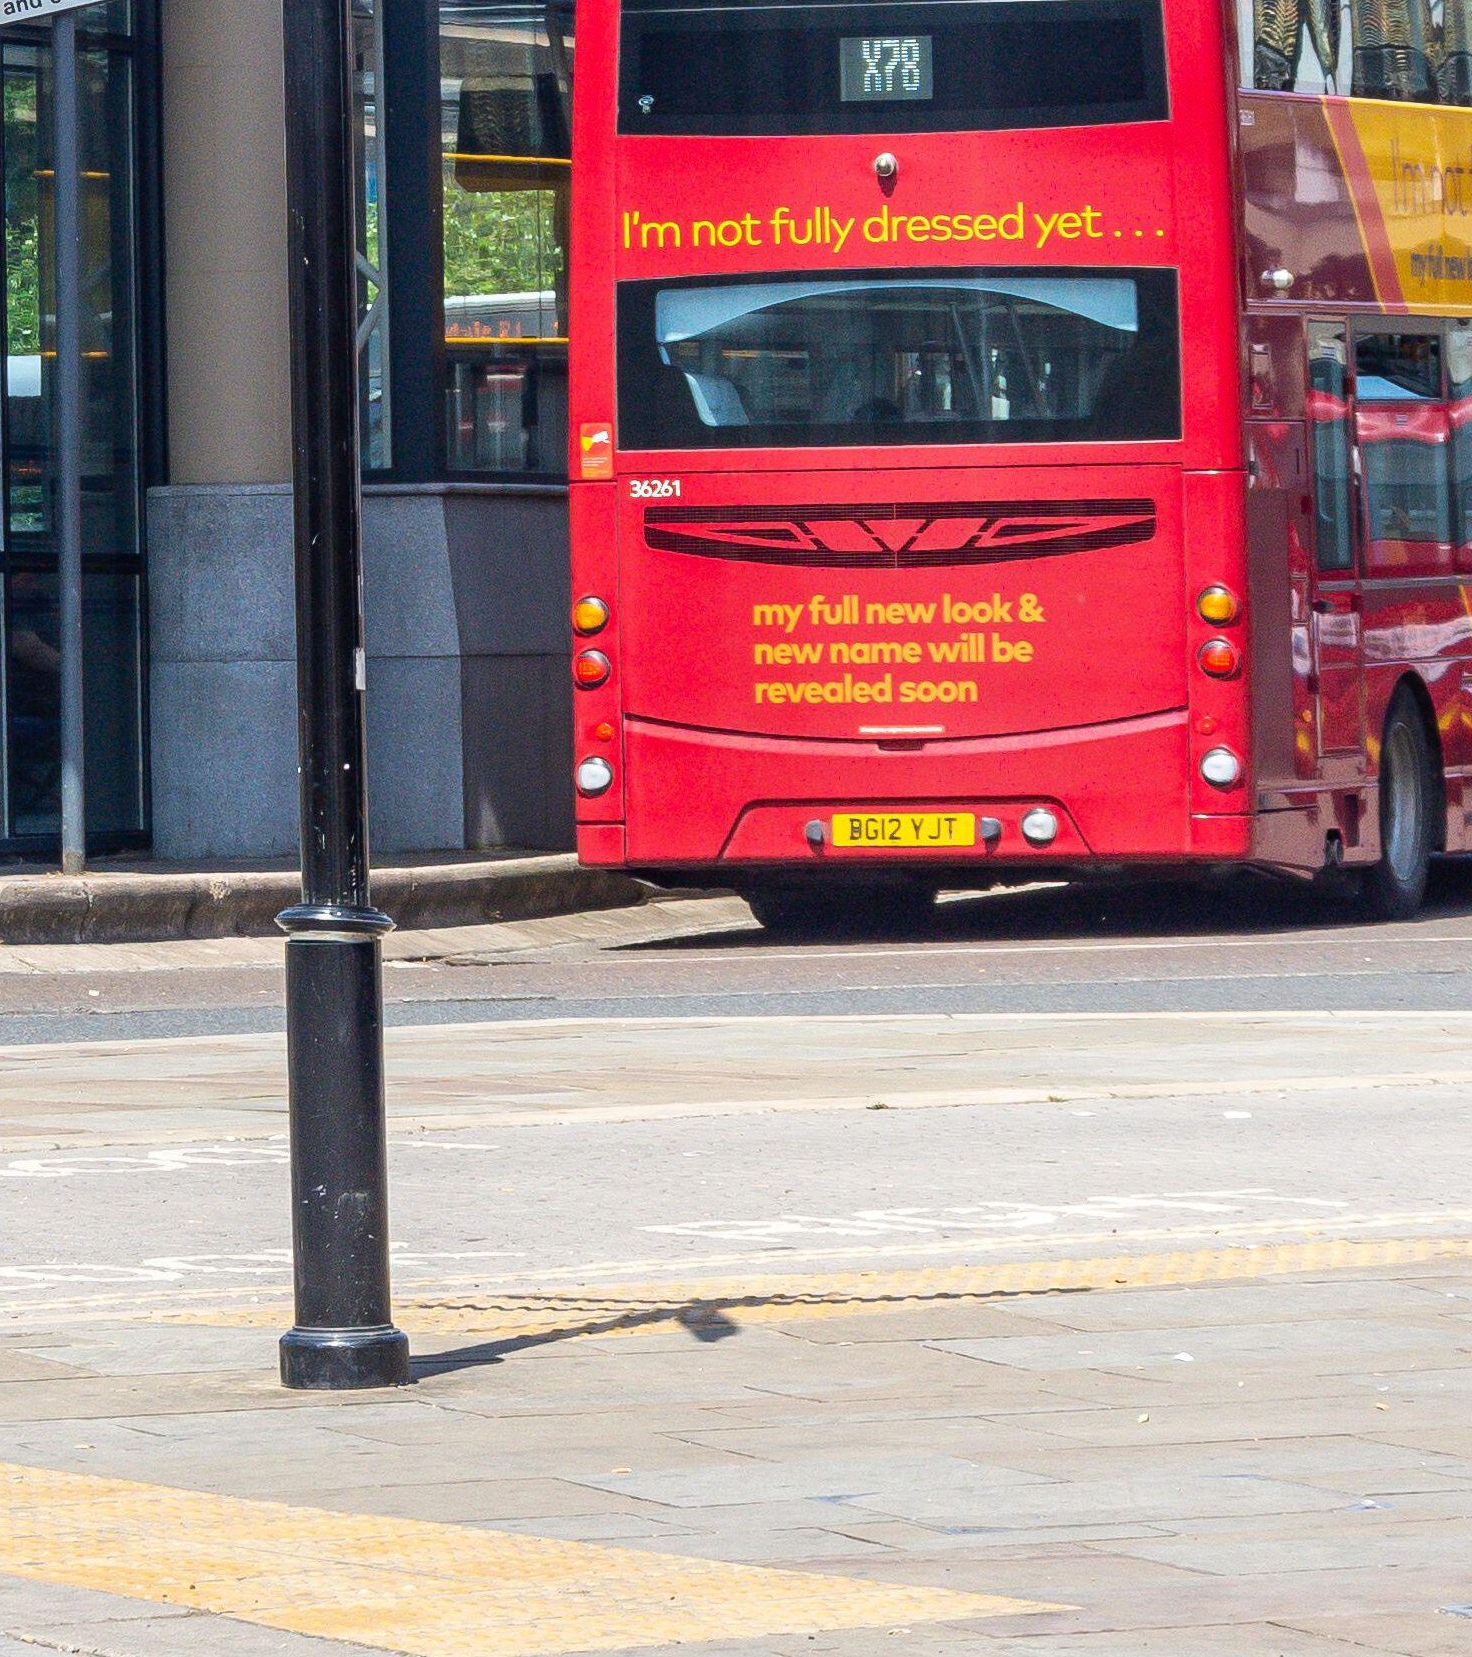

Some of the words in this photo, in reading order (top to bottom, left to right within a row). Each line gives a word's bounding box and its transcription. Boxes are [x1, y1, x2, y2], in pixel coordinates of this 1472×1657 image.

[862, 39, 920, 92] X78
[622, 210, 681, 248] I'm
[693, 214, 761, 247] not
[771, 207, 855, 253] fully
[863, 203, 1025, 245] dressed
[629, 479, 681, 498] 36261
[752, 601, 804, 633] my
[808, 593, 859, 627] full
[867, 601, 935, 625] new
[942, 593, 1011, 624] look
[1019, 593, 1046, 623] &
[754, 644, 822, 665] new
[830, 640, 921, 664] name
[927, 633, 985, 663] will
[992, 632, 1034, 662] be
[755, 673, 892, 704] revealed
[900, 677, 978, 703] soon
[849, 817, 902, 841] BG12
[910, 817, 958, 840] YJT
[635, 1187, 1352, 1243] RIGHT
